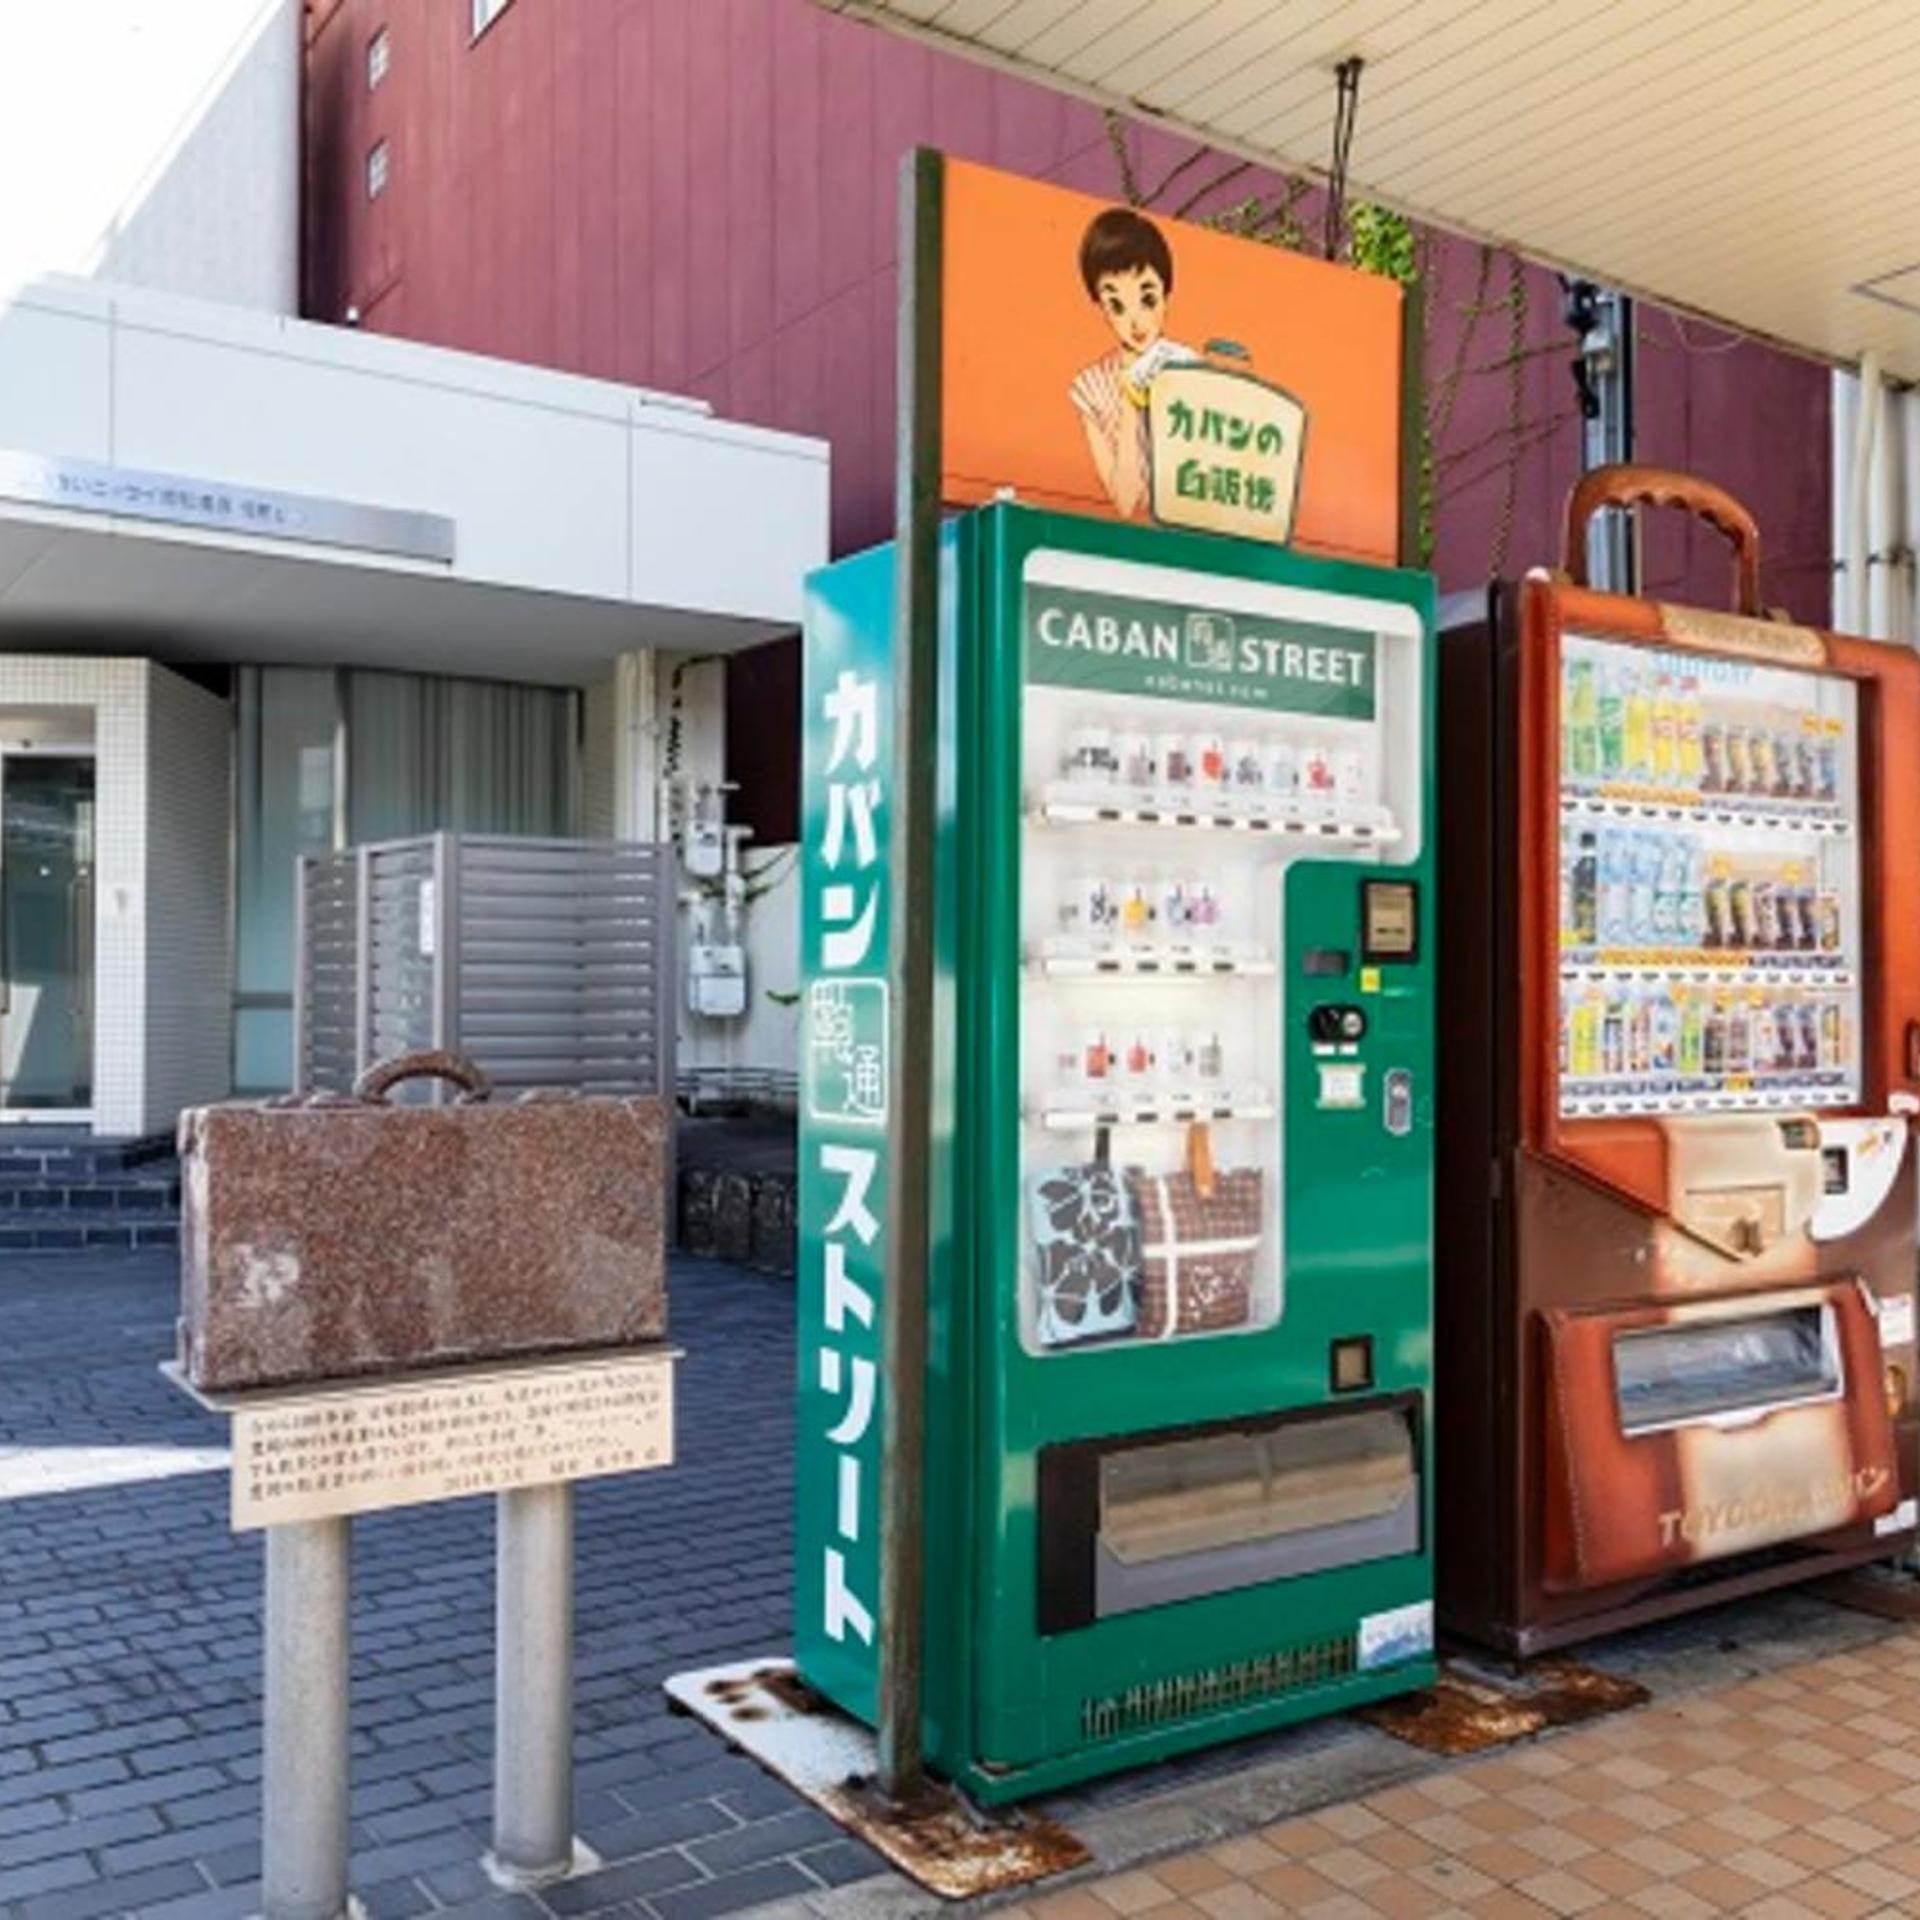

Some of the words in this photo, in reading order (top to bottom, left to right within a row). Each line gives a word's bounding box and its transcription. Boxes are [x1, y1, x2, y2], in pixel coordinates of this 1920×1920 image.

[1167, 398, 1283, 455] カバンの
[1037, 607, 1179, 662] CABAN
[1239, 639, 1366, 686] STREET
[820, 669, 881, 969] カバン
[819, 1143, 880, 1646] ストリート
